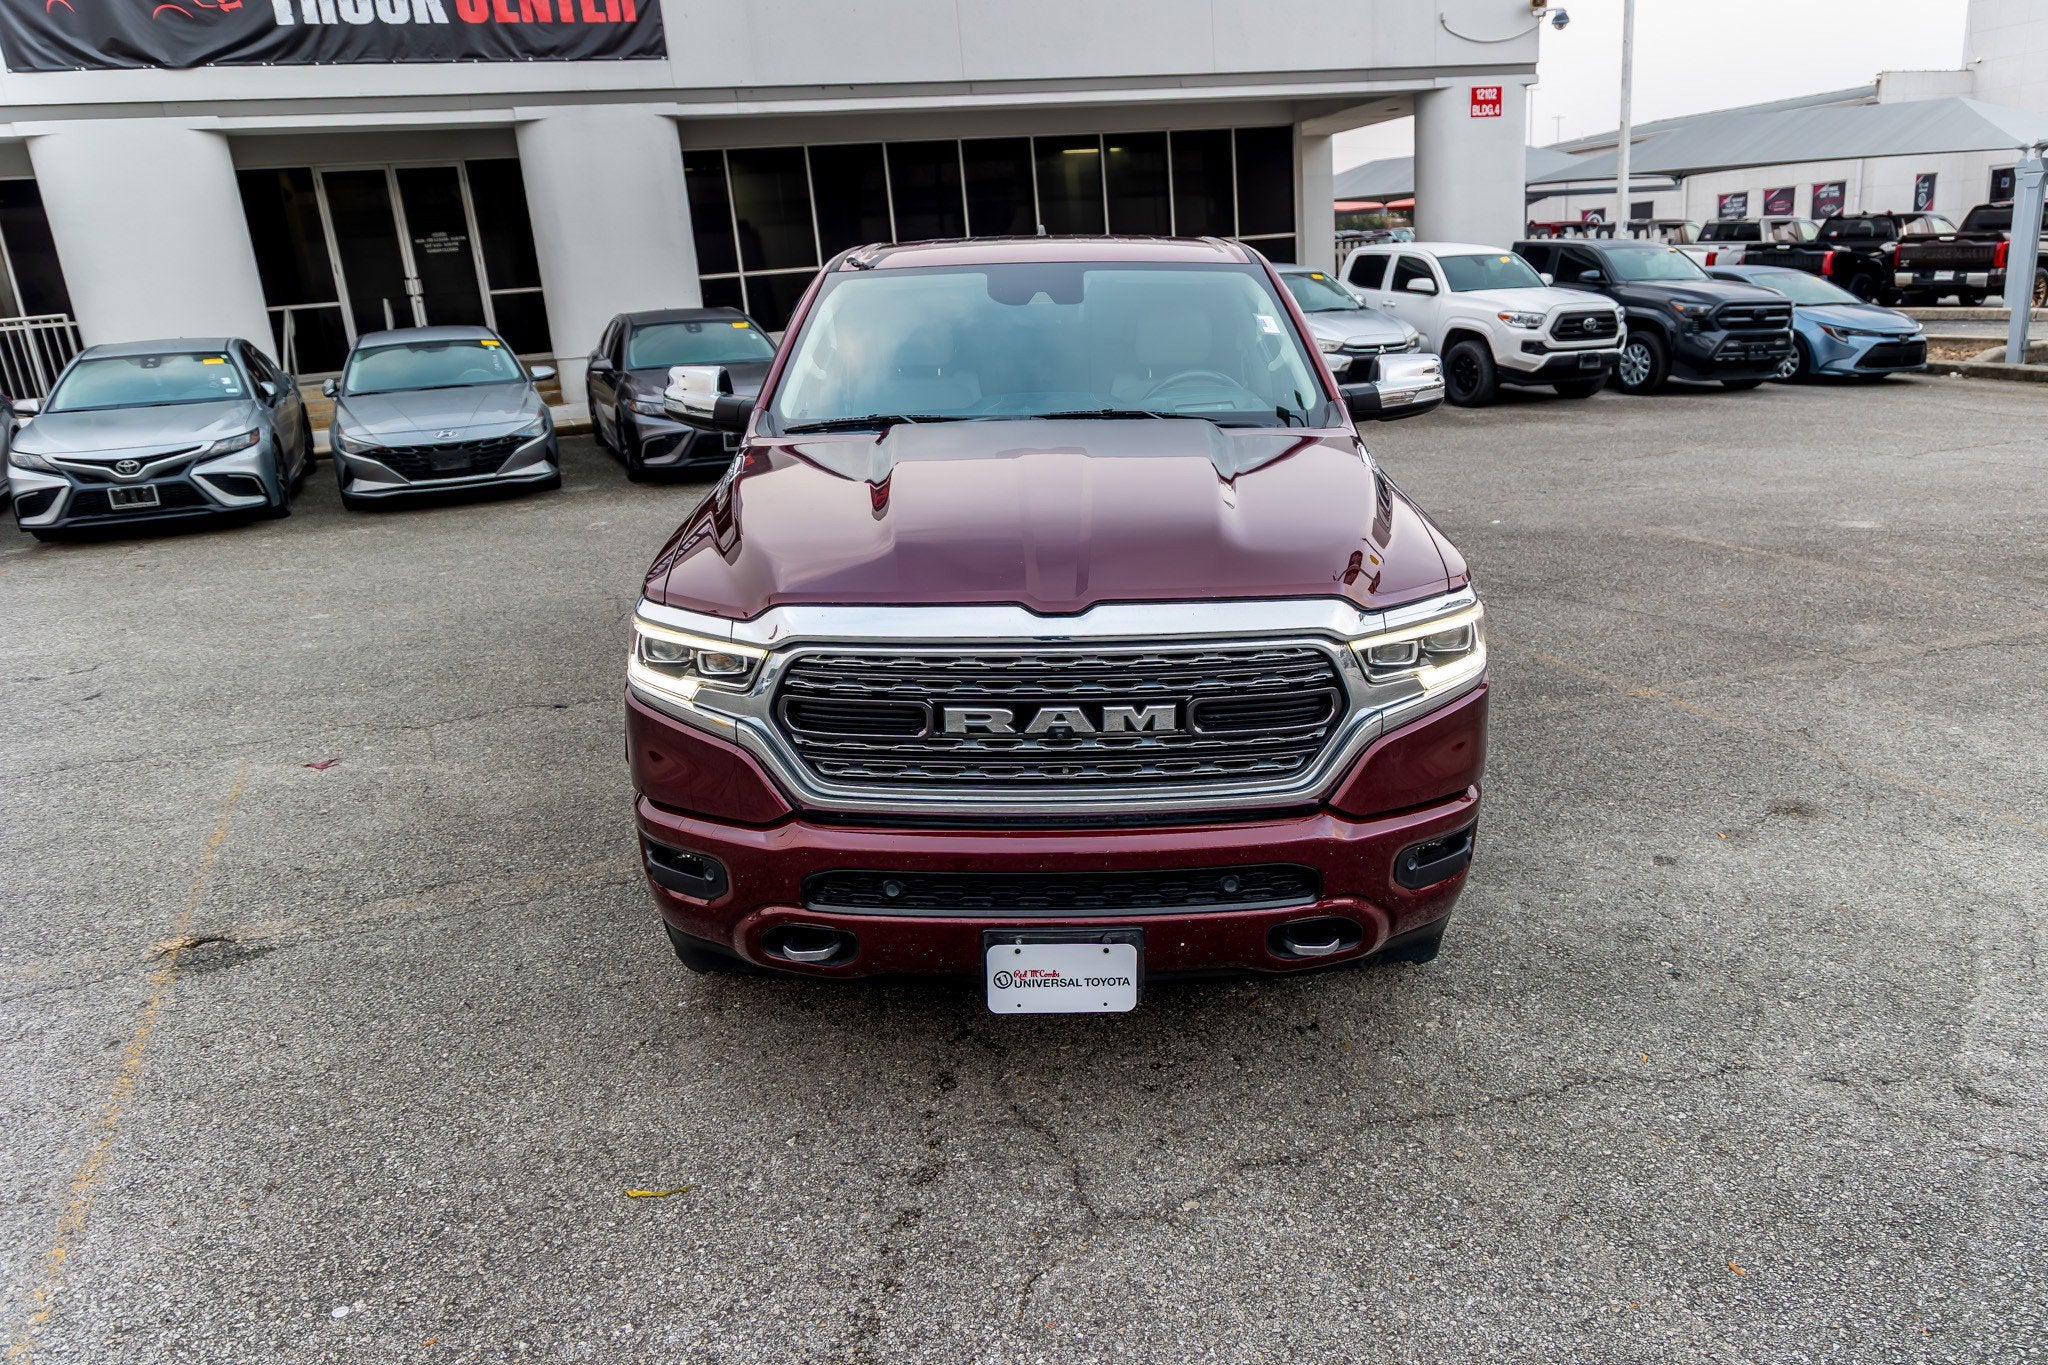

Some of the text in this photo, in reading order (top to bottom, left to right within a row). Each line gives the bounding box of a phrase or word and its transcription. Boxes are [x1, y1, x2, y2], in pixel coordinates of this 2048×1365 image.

[1476, 88, 1498, 100] 12102
[944, 705, 1177, 733] RAM
[1013, 969, 1060, 980] Red McCombs
[1013, 977, 1131, 988] UNIVERSAL TOYOTA
